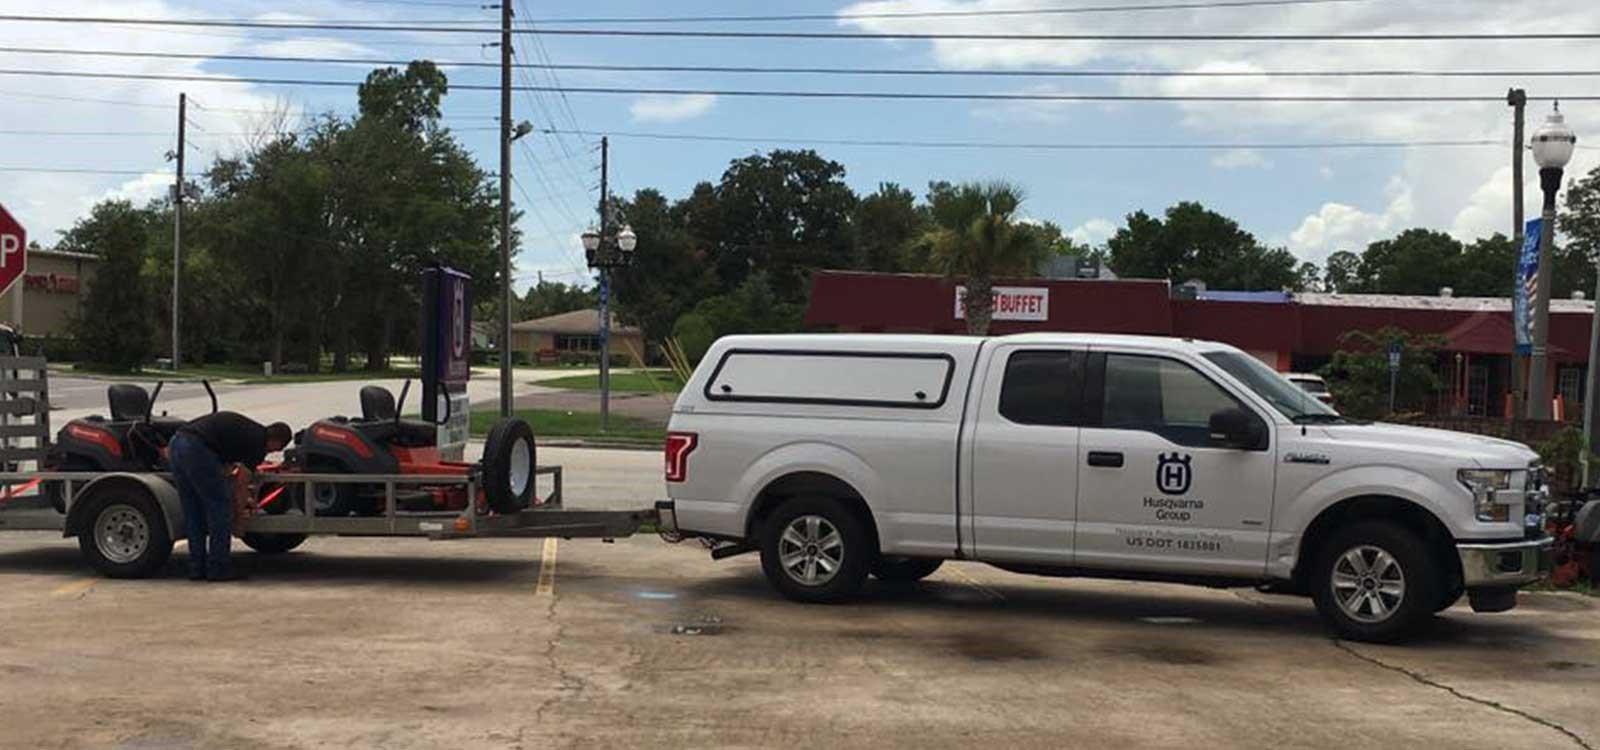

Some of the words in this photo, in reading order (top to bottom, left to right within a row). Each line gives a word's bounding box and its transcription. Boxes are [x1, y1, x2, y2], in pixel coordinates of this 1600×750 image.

[1000, 294, 1043, 313] BUFFET
[1165, 465, 1183, 487] H
[1143, 497, 1204, 510] Husqvarna
[1156, 509, 1191, 521] Group
[1127, 536, 1143, 546] US
[1146, 538, 1174, 548] DOT
